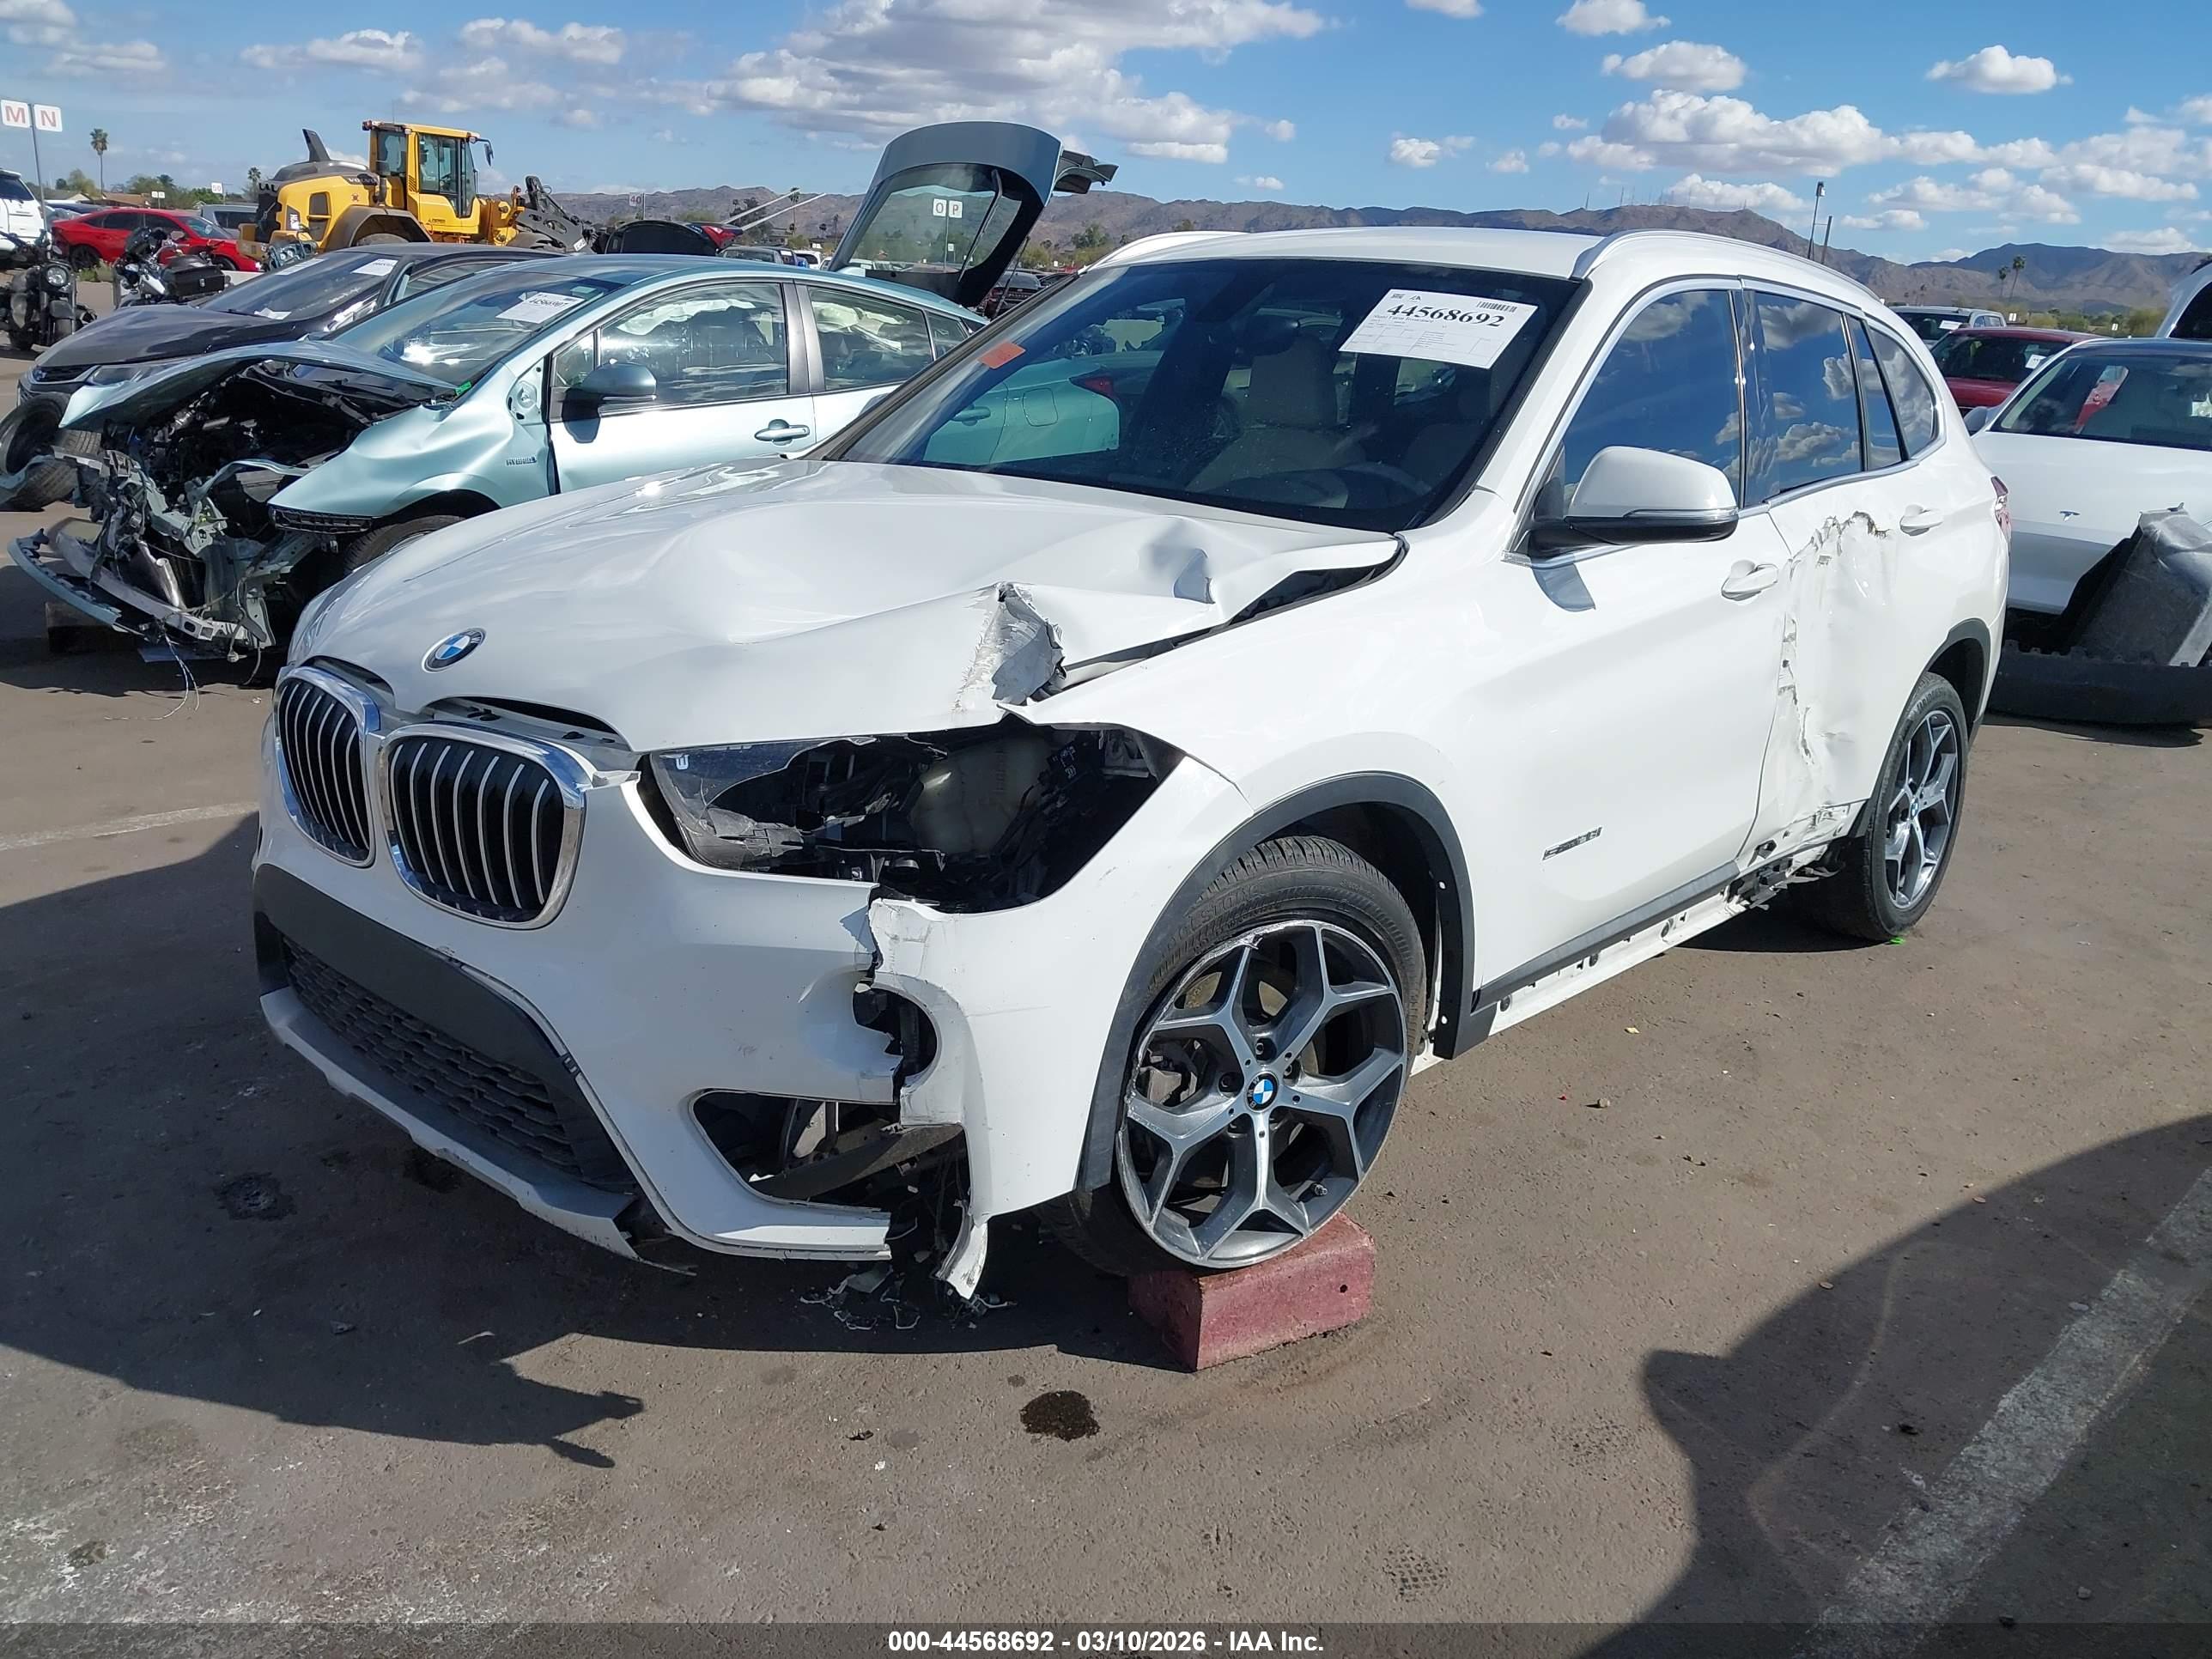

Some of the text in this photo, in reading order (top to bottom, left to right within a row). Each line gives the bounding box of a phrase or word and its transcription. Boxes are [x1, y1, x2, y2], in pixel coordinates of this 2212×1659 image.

[5, 106, 26, 124] M
[40, 110, 57, 127] N
[630, 195, 641, 204] 40
[952, 204, 959, 215] P
[1387, 304, 1505, 327] 44568692
[506, 456, 537, 466] HYBRID
